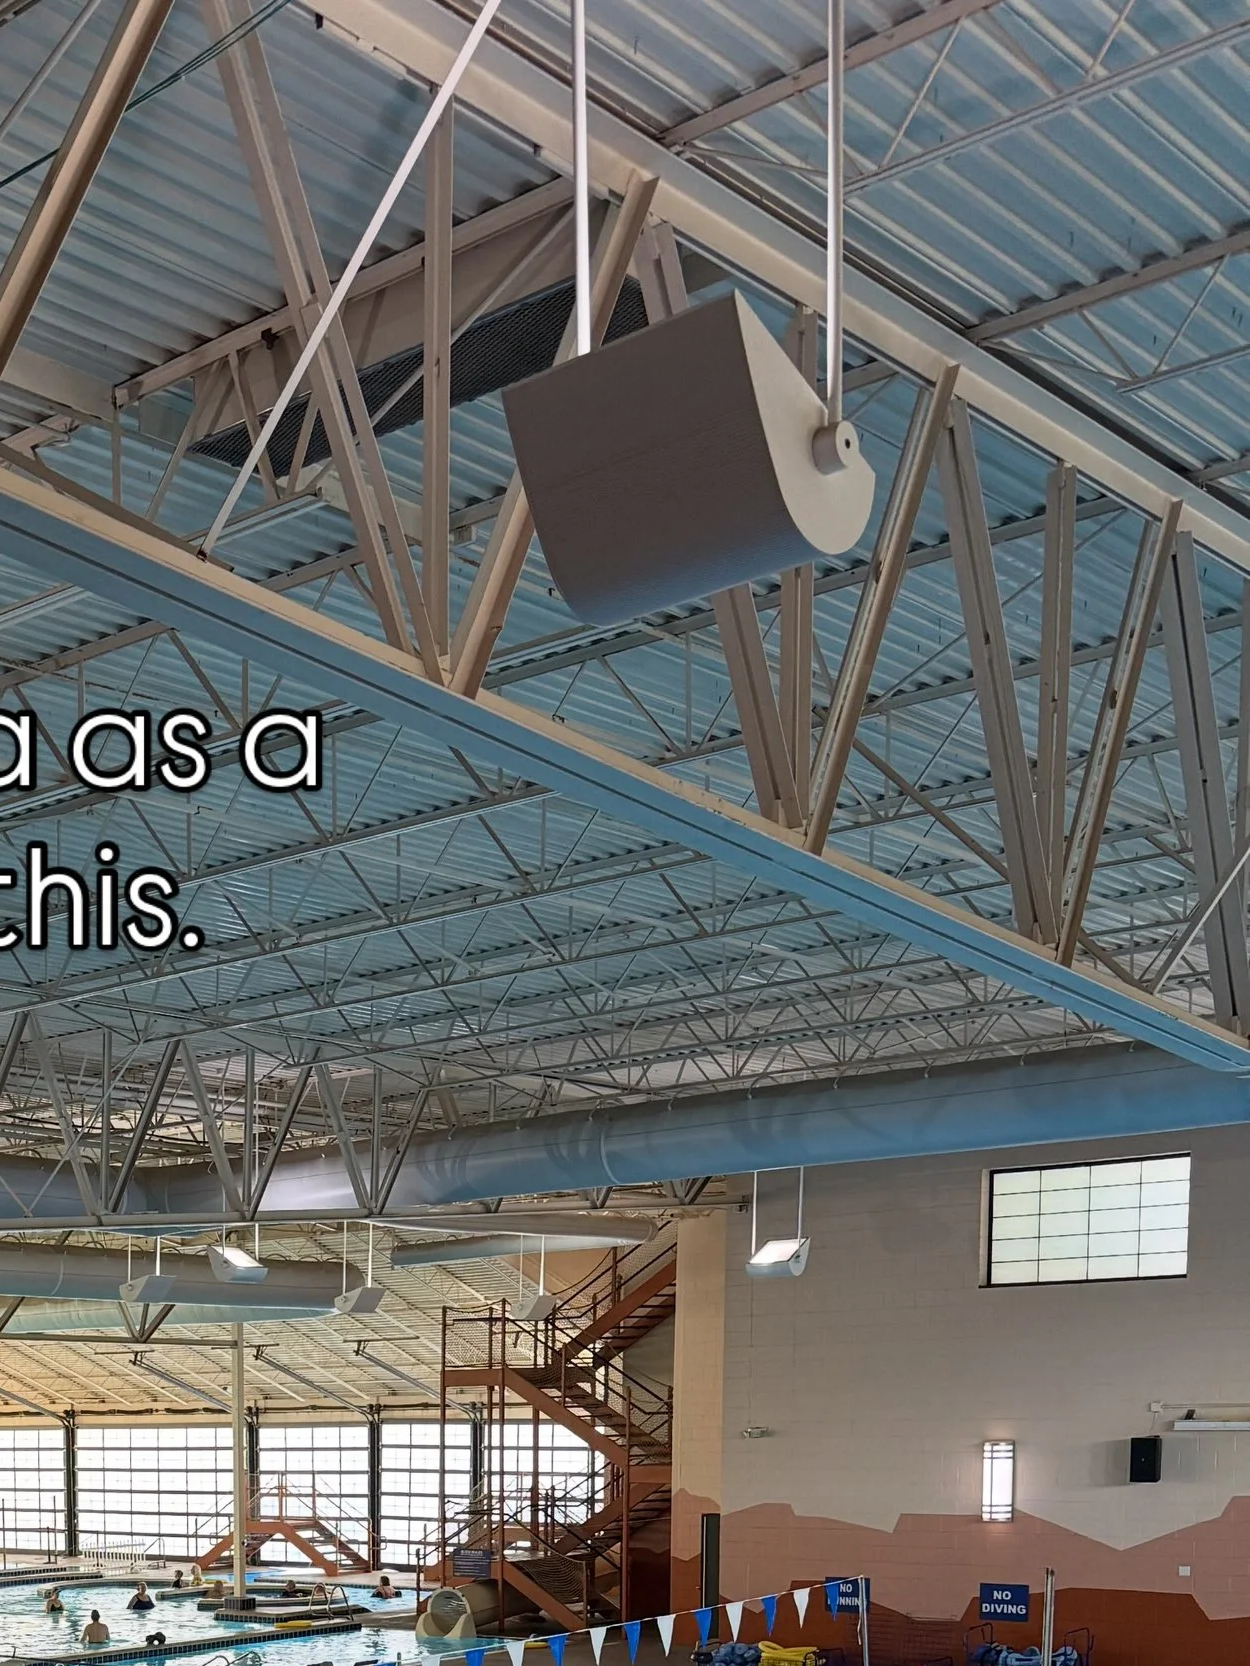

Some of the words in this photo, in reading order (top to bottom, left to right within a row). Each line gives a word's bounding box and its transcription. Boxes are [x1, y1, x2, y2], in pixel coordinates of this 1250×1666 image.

[840, 1583, 853, 1593] NO
[993, 1590, 1012, 1600] NO
[827, 1596, 865, 1606] NNIN
[981, 1603, 1027, 1615] DIVING
